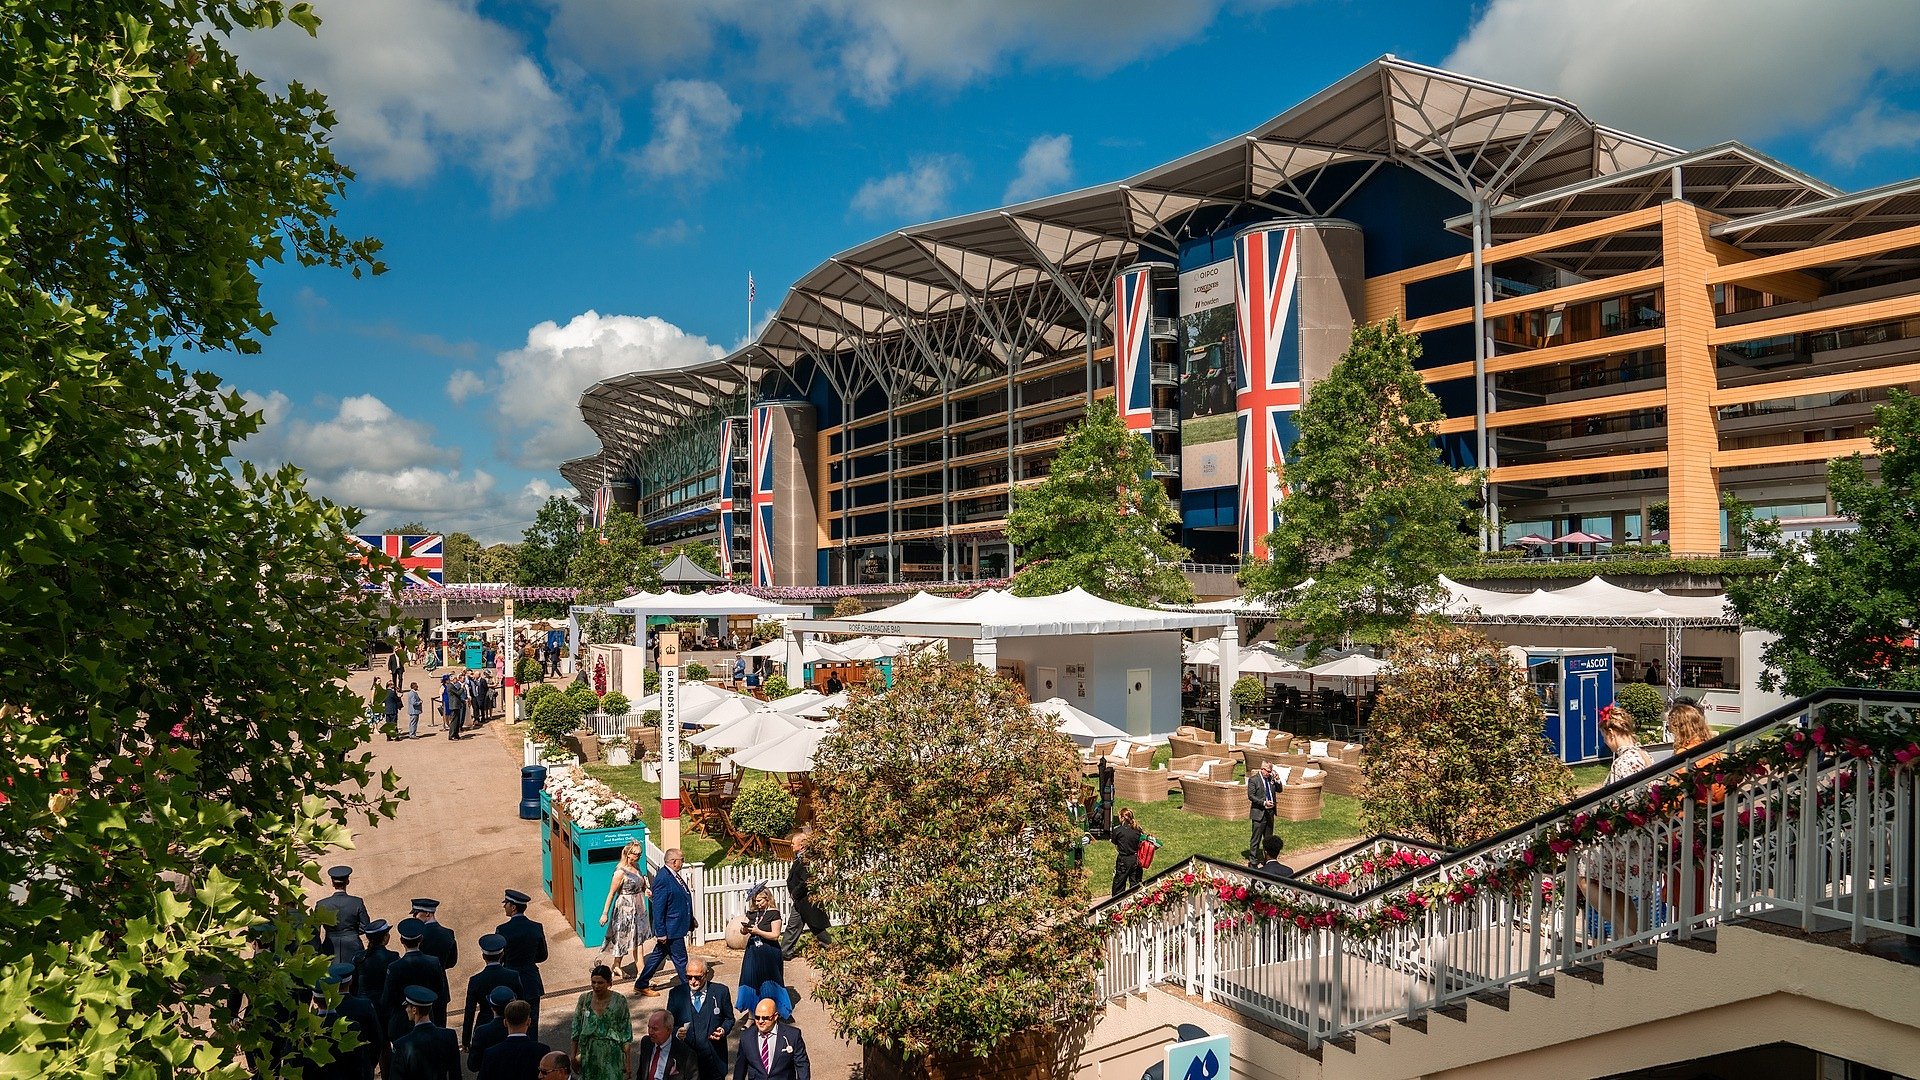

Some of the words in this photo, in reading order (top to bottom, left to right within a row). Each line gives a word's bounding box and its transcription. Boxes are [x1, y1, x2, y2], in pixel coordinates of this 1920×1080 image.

[861, 624, 890, 633] CHAMPAGNE
[890, 625, 901, 634] BAR
[1570, 659, 1581, 669] BET
[1586, 658, 1608, 669] ASCOT
[667, 670, 675, 733] GRANDSTAND
[667, 736, 675, 762] LAWN
